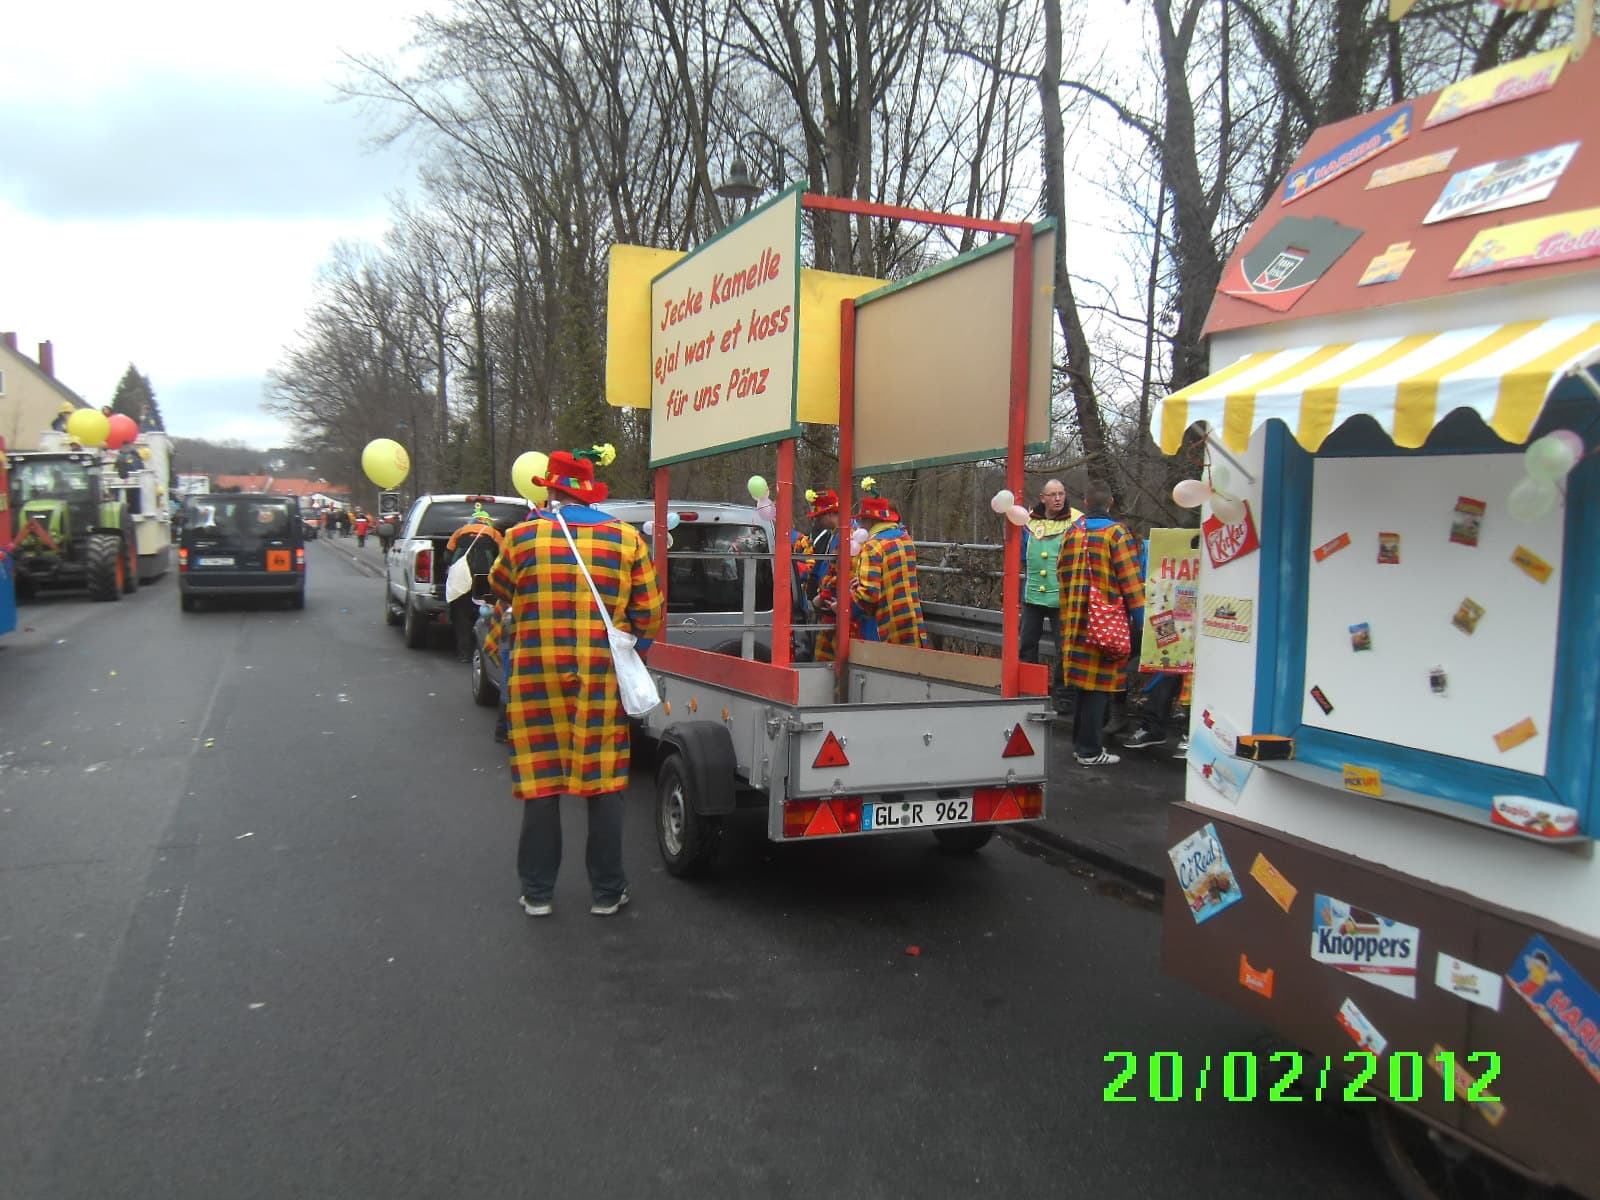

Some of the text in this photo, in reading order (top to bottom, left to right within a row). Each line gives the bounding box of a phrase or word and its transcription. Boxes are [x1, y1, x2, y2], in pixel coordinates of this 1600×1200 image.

[1314, 134, 1382, 181] HARIBO
[1436, 156, 1564, 215] Knoppers
[661, 247, 781, 331] Jecke Kamelle
[654, 304, 791, 384] ejal wat et koss
[666, 367, 770, 421] für uns Pänz
[875, 806, 900, 826] GL
[912, 804, 923, 823] R
[935, 801, 969, 821] 962
[1319, 927, 1411, 962] Knoppers
